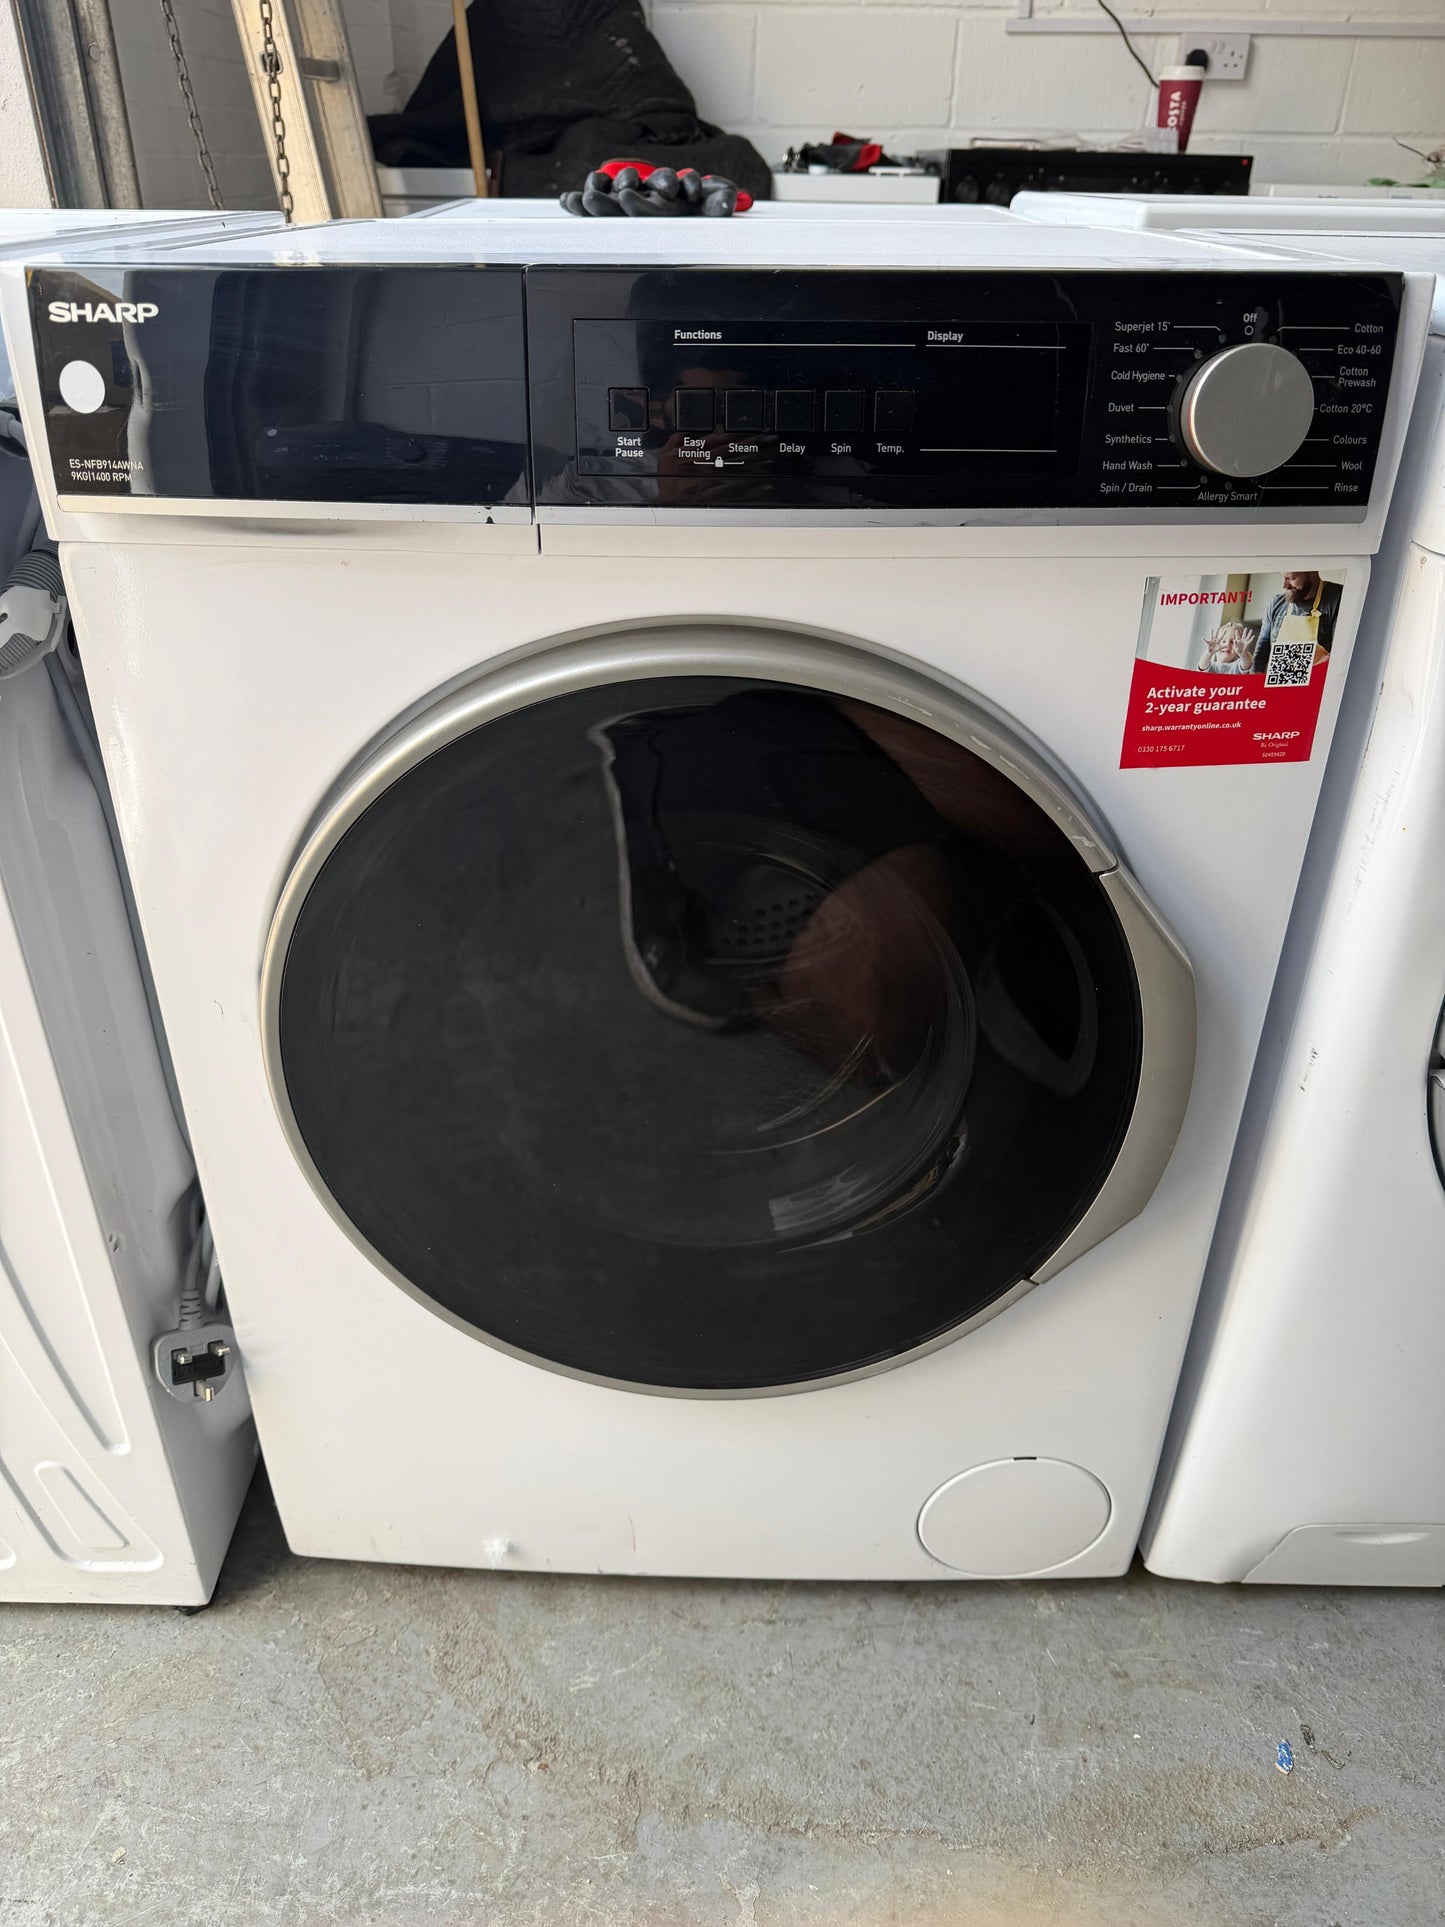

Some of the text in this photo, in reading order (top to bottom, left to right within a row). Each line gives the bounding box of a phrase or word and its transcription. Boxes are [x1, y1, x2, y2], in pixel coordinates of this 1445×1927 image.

[48, 301, 159, 323] SHARP
[1243, 313, 1258, 323] Off
[1114, 321, 1154, 333] Superjet
[1354, 323, 1384, 333] Cotton
[674, 329, 722, 340] Functions
[927, 330, 964, 343] Display
[1113, 343, 1133, 353] Fast
[1337, 345, 1382, 355] Eco 40-60
[1110, 370, 1165, 382] Cold Hygiene
[1339, 366, 1369, 377] Cotton
[1338, 378, 1377, 388] Prewash
[1108, 403, 1135, 412] Duvet
[1319, 404, 1349, 413] Cotton
[617, 437, 641, 446] Start
[683, 437, 706, 449] Easy
[1105, 435, 1152, 446] Synthetics
[1333, 435, 1368, 445] Colours
[615, 447, 644, 457] Pause
[728, 443, 759, 453] Steam
[779, 443, 806, 455] Delay
[831, 443, 852, 454] Spin
[876, 443, 905, 455] Temp.
[678, 448, 711, 460] Ironing
[69, 459, 144, 470] ES-NFB914AWNA
[1102, 461, 1153, 471] Hand Wash
[1341, 461, 1363, 471] Wool
[112, 473, 132, 482] RPM
[1100, 483, 1119, 494] Spin
[1128, 483, 1153, 493] Drain
[1334, 482, 1359, 492] Rinse
[1198, 491, 1258, 503] Allergy Smart
[1160, 591, 1253, 606] IMPORTANT!
[1147, 684, 1243, 699] Activate your
[1144, 698, 1267, 715] 2-year guarantee
[1142, 721, 1242, 732] sharp.warrantyonline.co.uk
[1252, 731, 1300, 741] SHARP
[1155, 745, 1167, 753] 175
[1268, 741, 1289, 749] Original
